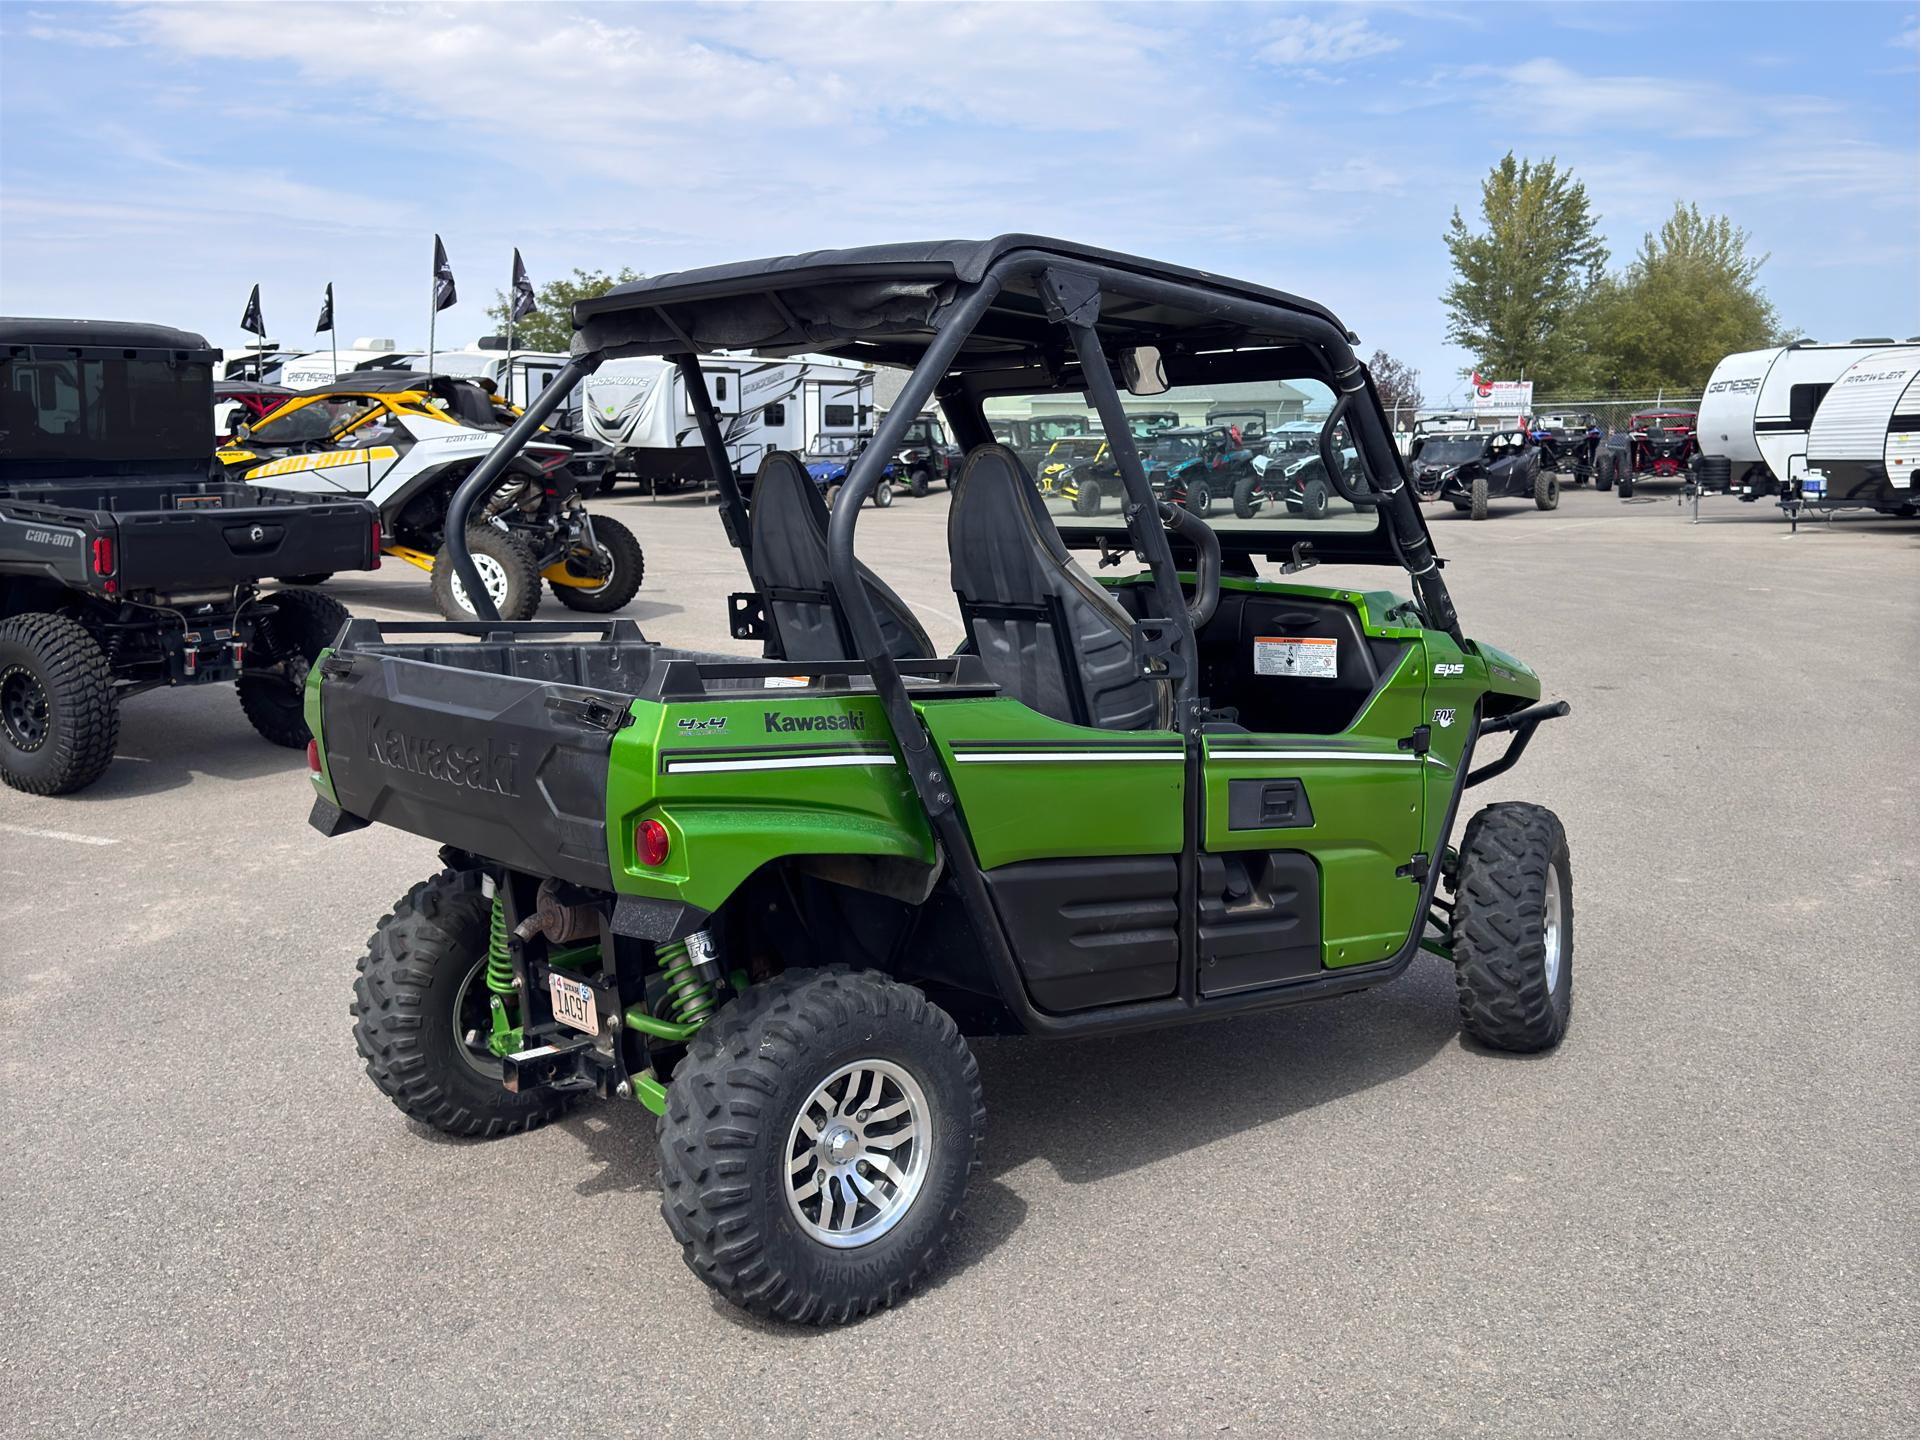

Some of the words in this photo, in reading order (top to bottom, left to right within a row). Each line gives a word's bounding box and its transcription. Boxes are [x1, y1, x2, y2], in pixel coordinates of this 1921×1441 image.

[587, 376, 651, 388] SHOCKWAVE
[1708, 377, 1762, 393] GENESIS
[1842, 370, 1907, 385] PROWLER
[446, 433, 488, 443] can-am
[261, 449, 358, 477] can-am
[25, 529, 75, 548] can-am
[677, 716, 728, 730] 4x4
[764, 711, 866, 733] Kawasaki
[1432, 709, 1456, 728] FOX
[367, 713, 521, 798] Kawasaki
[563, 982, 580, 996] UTAH
